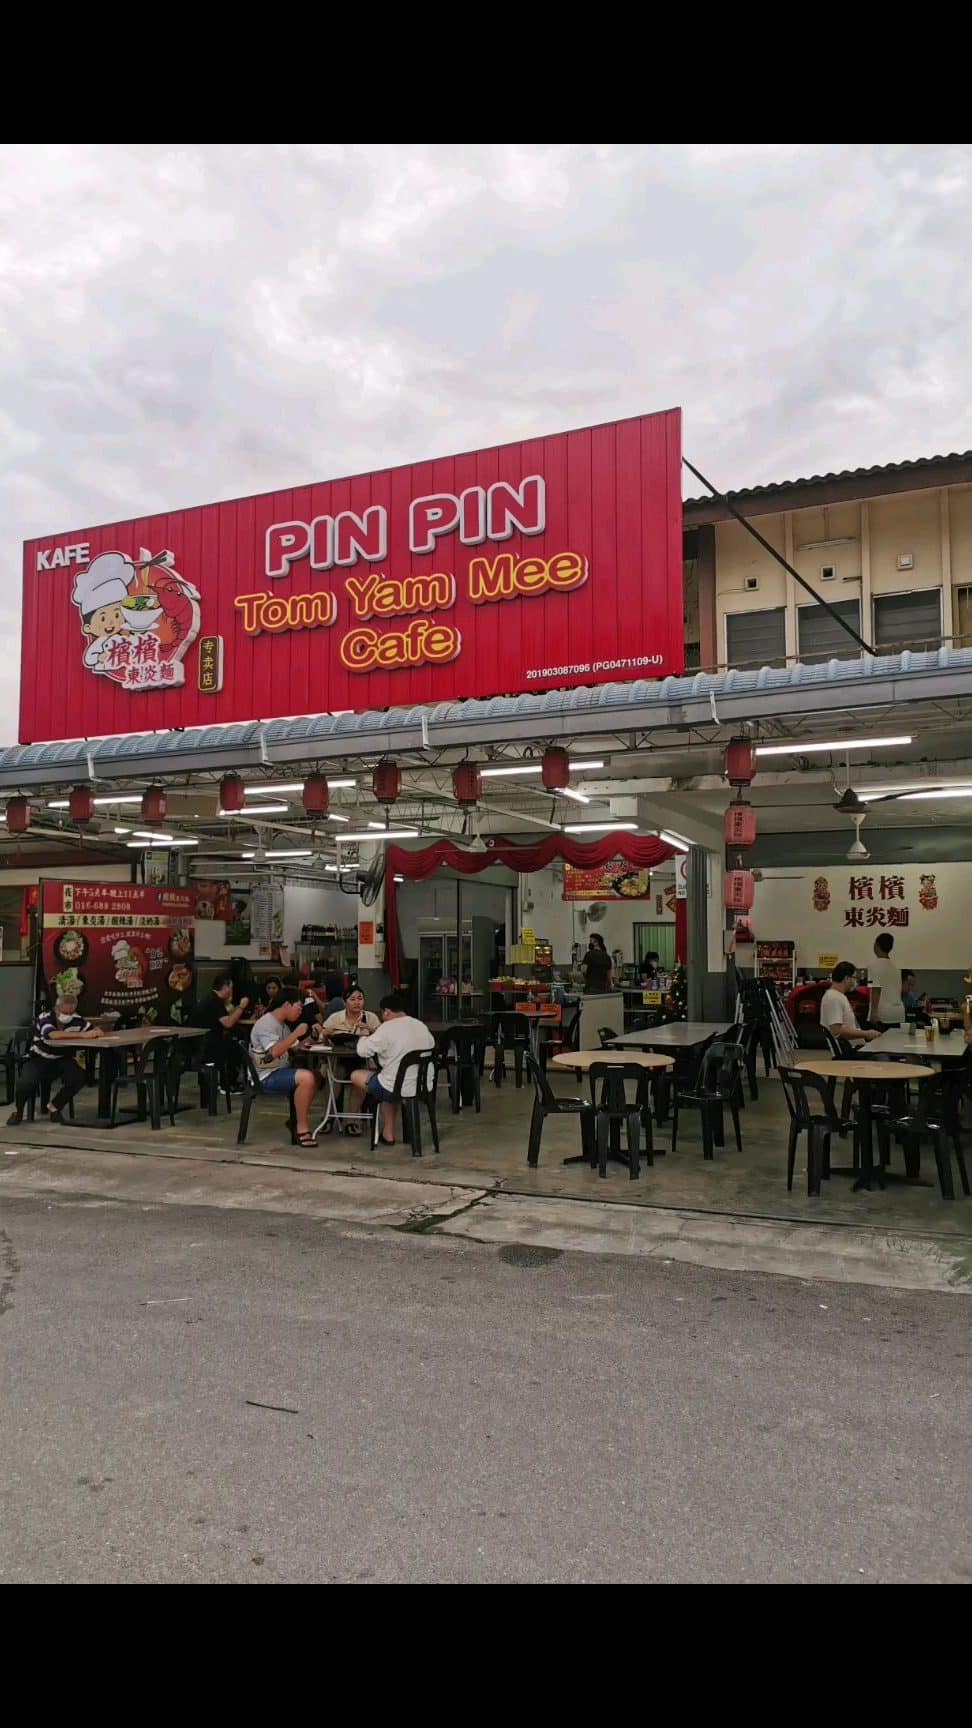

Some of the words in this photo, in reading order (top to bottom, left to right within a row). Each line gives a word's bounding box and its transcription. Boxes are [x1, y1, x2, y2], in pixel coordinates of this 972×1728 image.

[266, 505, 387, 577] PIN
[409, 474, 546, 553] PIN
[36, 543, 90, 571] KAFE
[235, 591, 336, 635] Tom
[345, 572, 455, 619] Yam
[469, 552, 587, 603] Mee
[201, 640, 215, 686] 专卖店
[341, 619, 460, 672] Cafe
[592, 654, 663, 673] (PG0471109-U)
[126, 661, 175, 685] 東炎麵
[843, 906, 909, 928] 東炎麵
